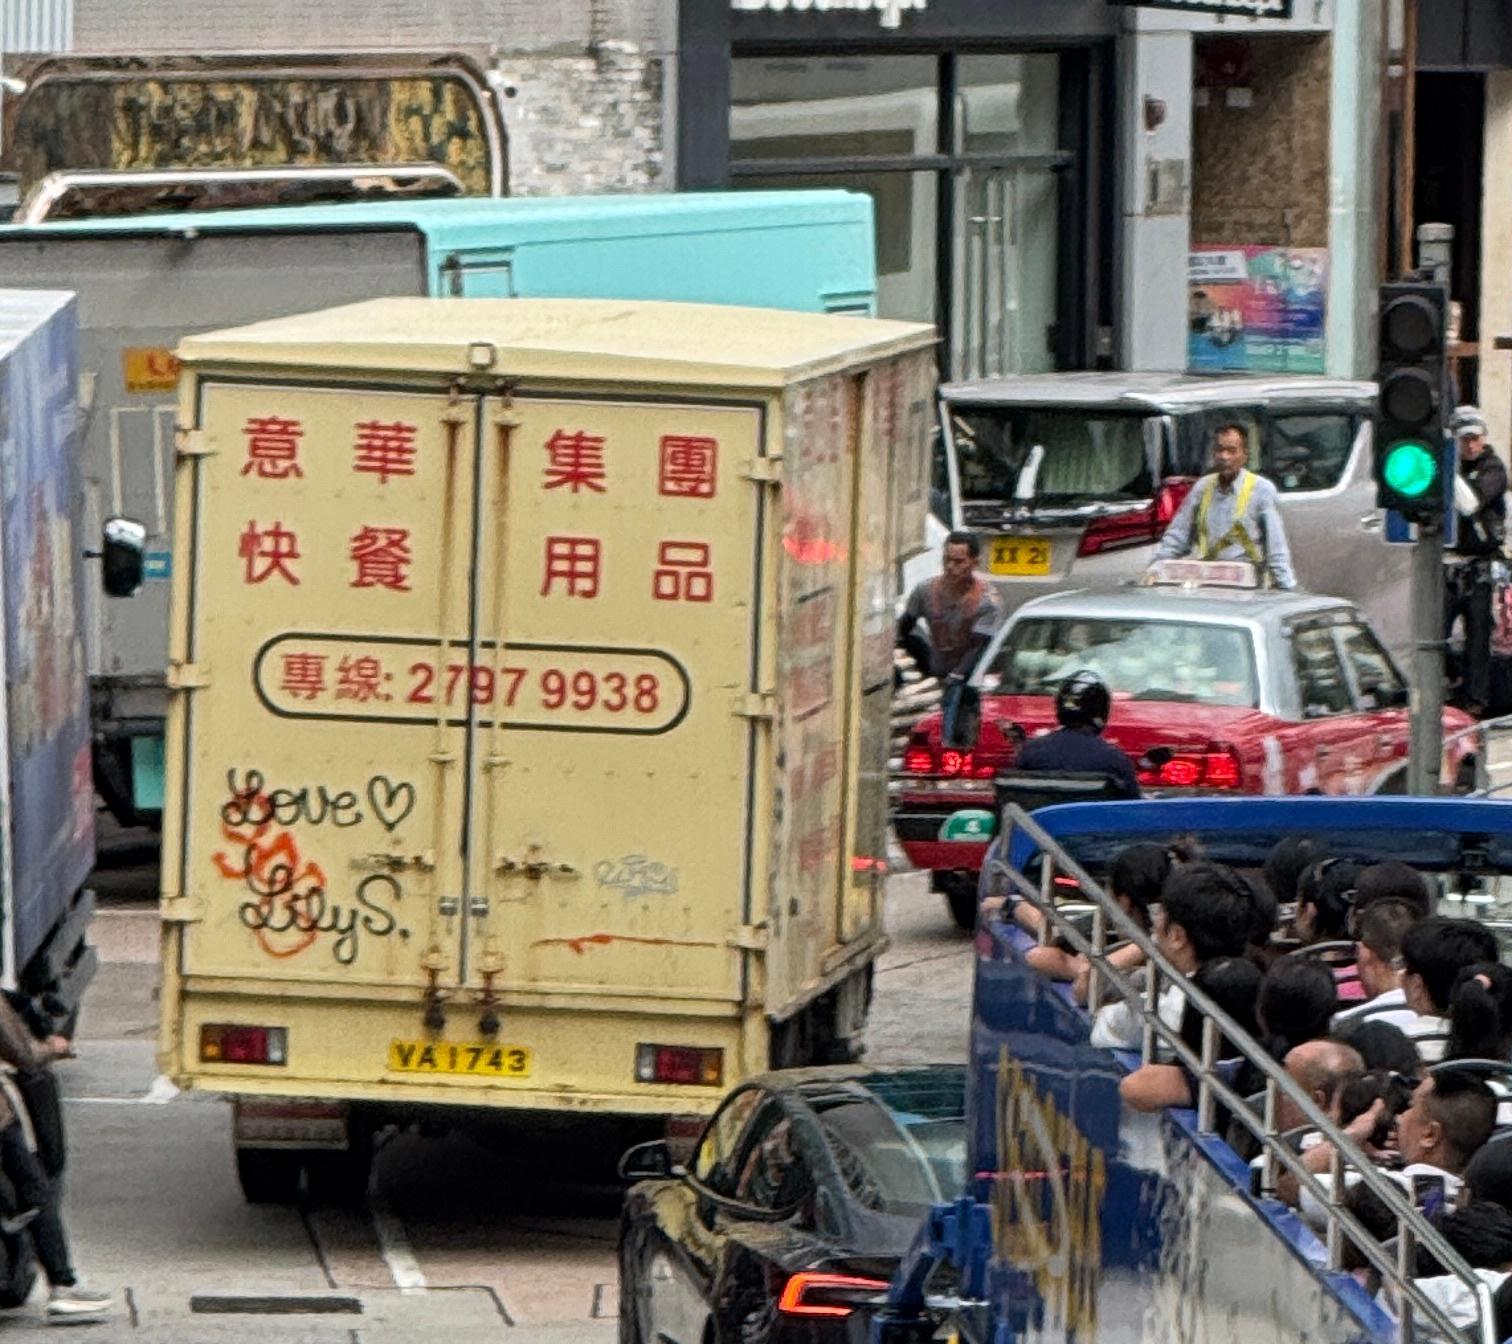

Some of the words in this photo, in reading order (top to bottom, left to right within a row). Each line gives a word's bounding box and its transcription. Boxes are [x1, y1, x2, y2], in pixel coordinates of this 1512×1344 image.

[240, 415, 718, 500] 意華集團
[238, 519, 714, 603] 快餐用品
[408, 660, 525, 709] 2797
[541, 668, 661, 715] 9938
[221, 767, 365, 828] Love
[396, 1044, 437, 1069] VA
[448, 1046, 526, 1072] 1743
